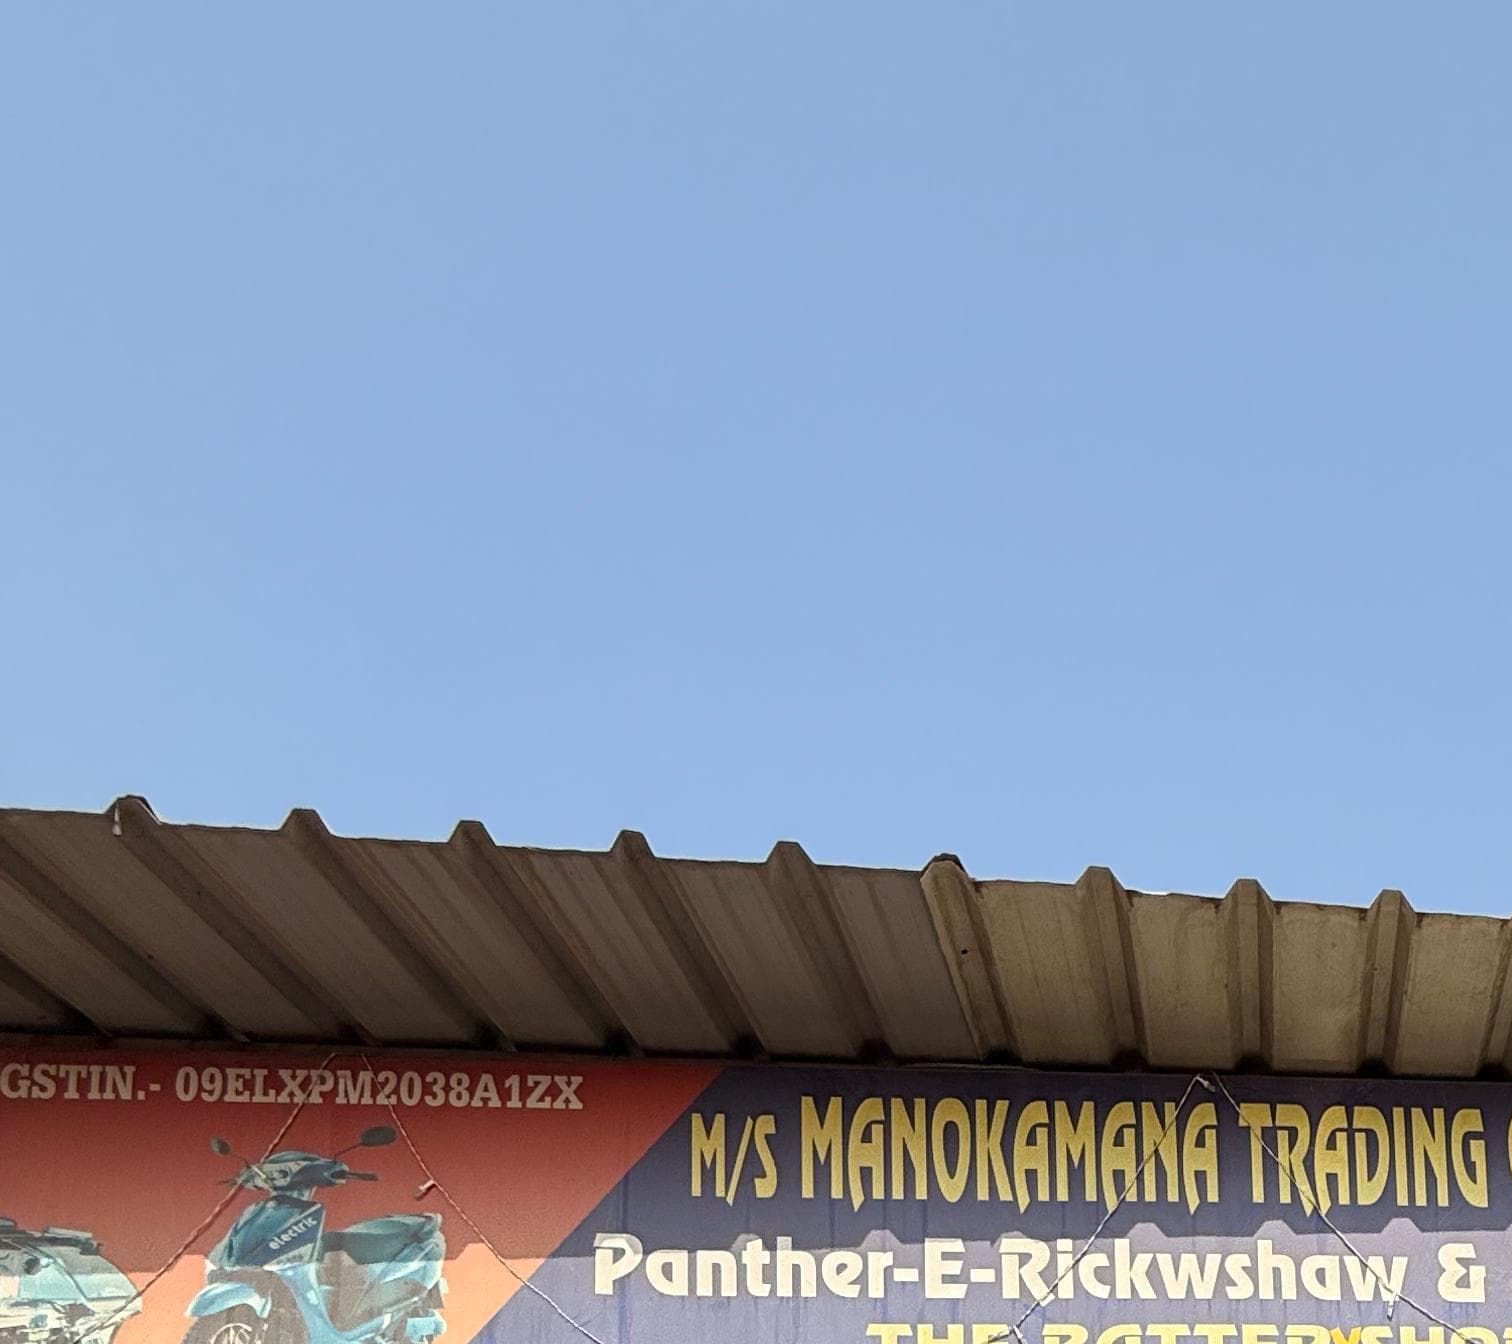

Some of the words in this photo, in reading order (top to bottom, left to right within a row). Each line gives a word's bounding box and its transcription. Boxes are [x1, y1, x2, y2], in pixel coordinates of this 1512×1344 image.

[175, 1065, 584, 1110] 09ELXPM2038A1ZX
[690, 1112, 778, 1206] M/S
[801, 1095, 1220, 1215] MANOKAMANA
[1239, 1102, 1489, 1217] TRADING
[593, 1233, 1409, 1305] Panther-E-Rickwshaw
[1437, 1242, 1487, 1304] &
